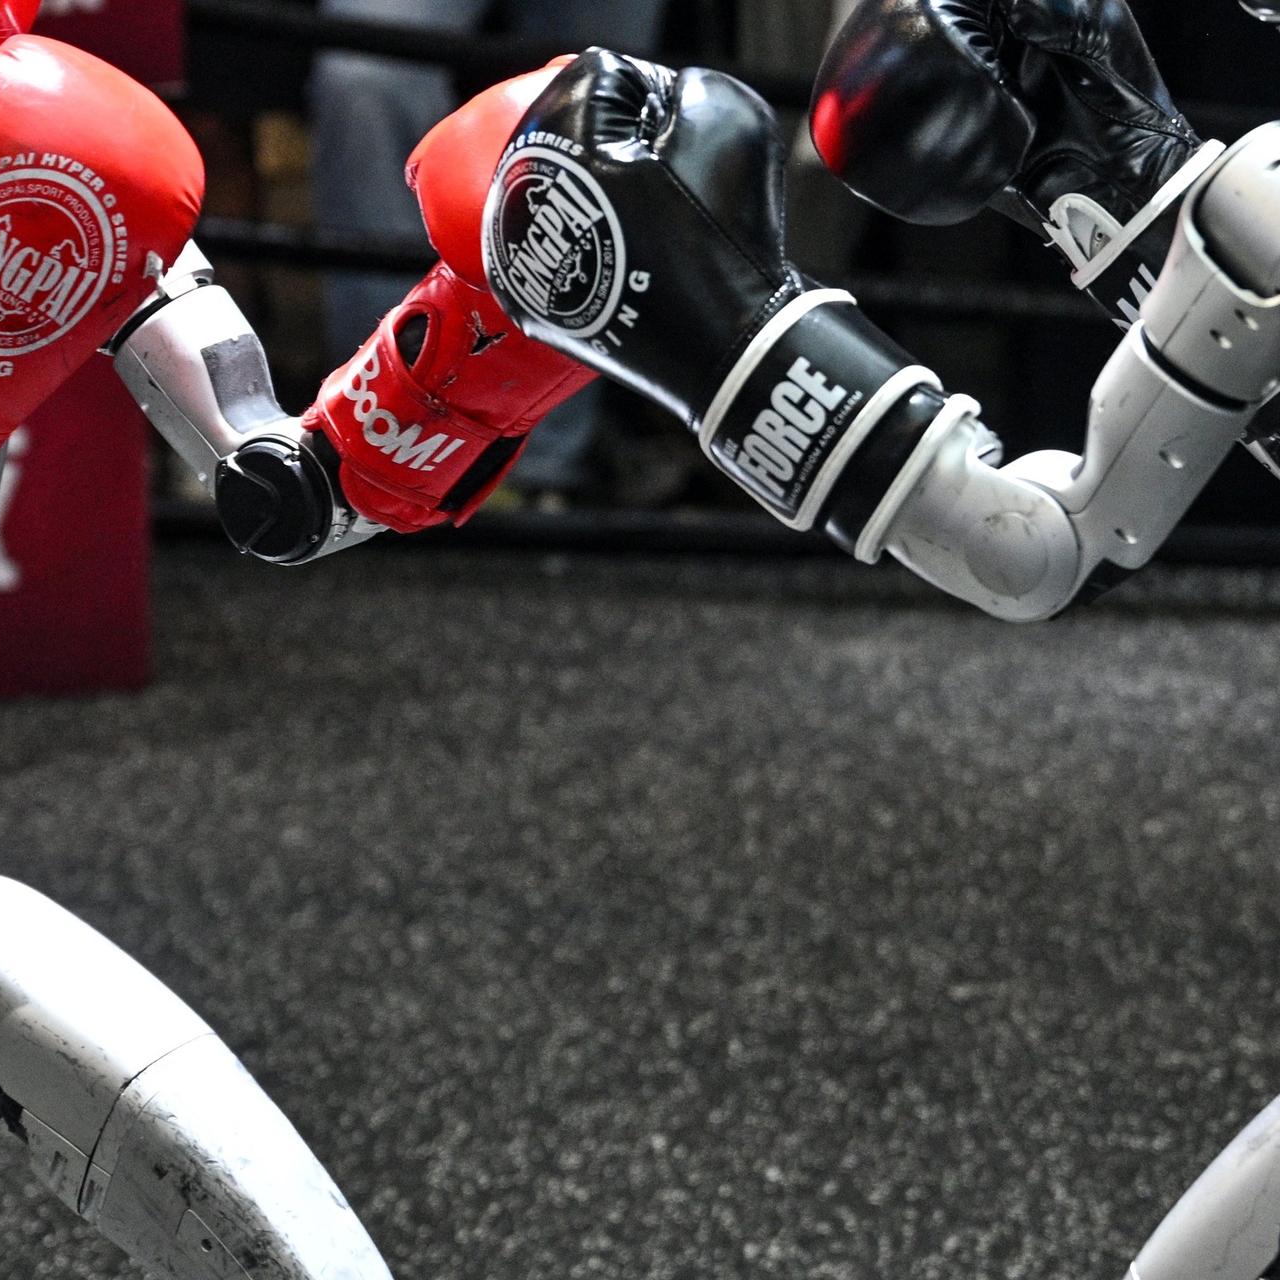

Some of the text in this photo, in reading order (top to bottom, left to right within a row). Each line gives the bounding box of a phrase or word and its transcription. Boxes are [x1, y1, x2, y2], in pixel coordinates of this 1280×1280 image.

[527, 130, 584, 157] SERIES
[27, 183, 65, 199] SPORT
[65, 193, 99, 246] PRODUCTS
[40, 152, 106, 191] HYPER
[102, 193, 118, 209] G
[111, 212, 129, 284] SERIES
[508, 169, 604, 317] GINGPAI
[603, 239, 613, 265] 2014
[597, 267, 613, 299] SINCE
[736, 356, 847, 498] FORCE
[799, 447, 821, 482] WISDOM
[819, 424, 836, 448] AND
[833, 390, 863, 425] CHARM
